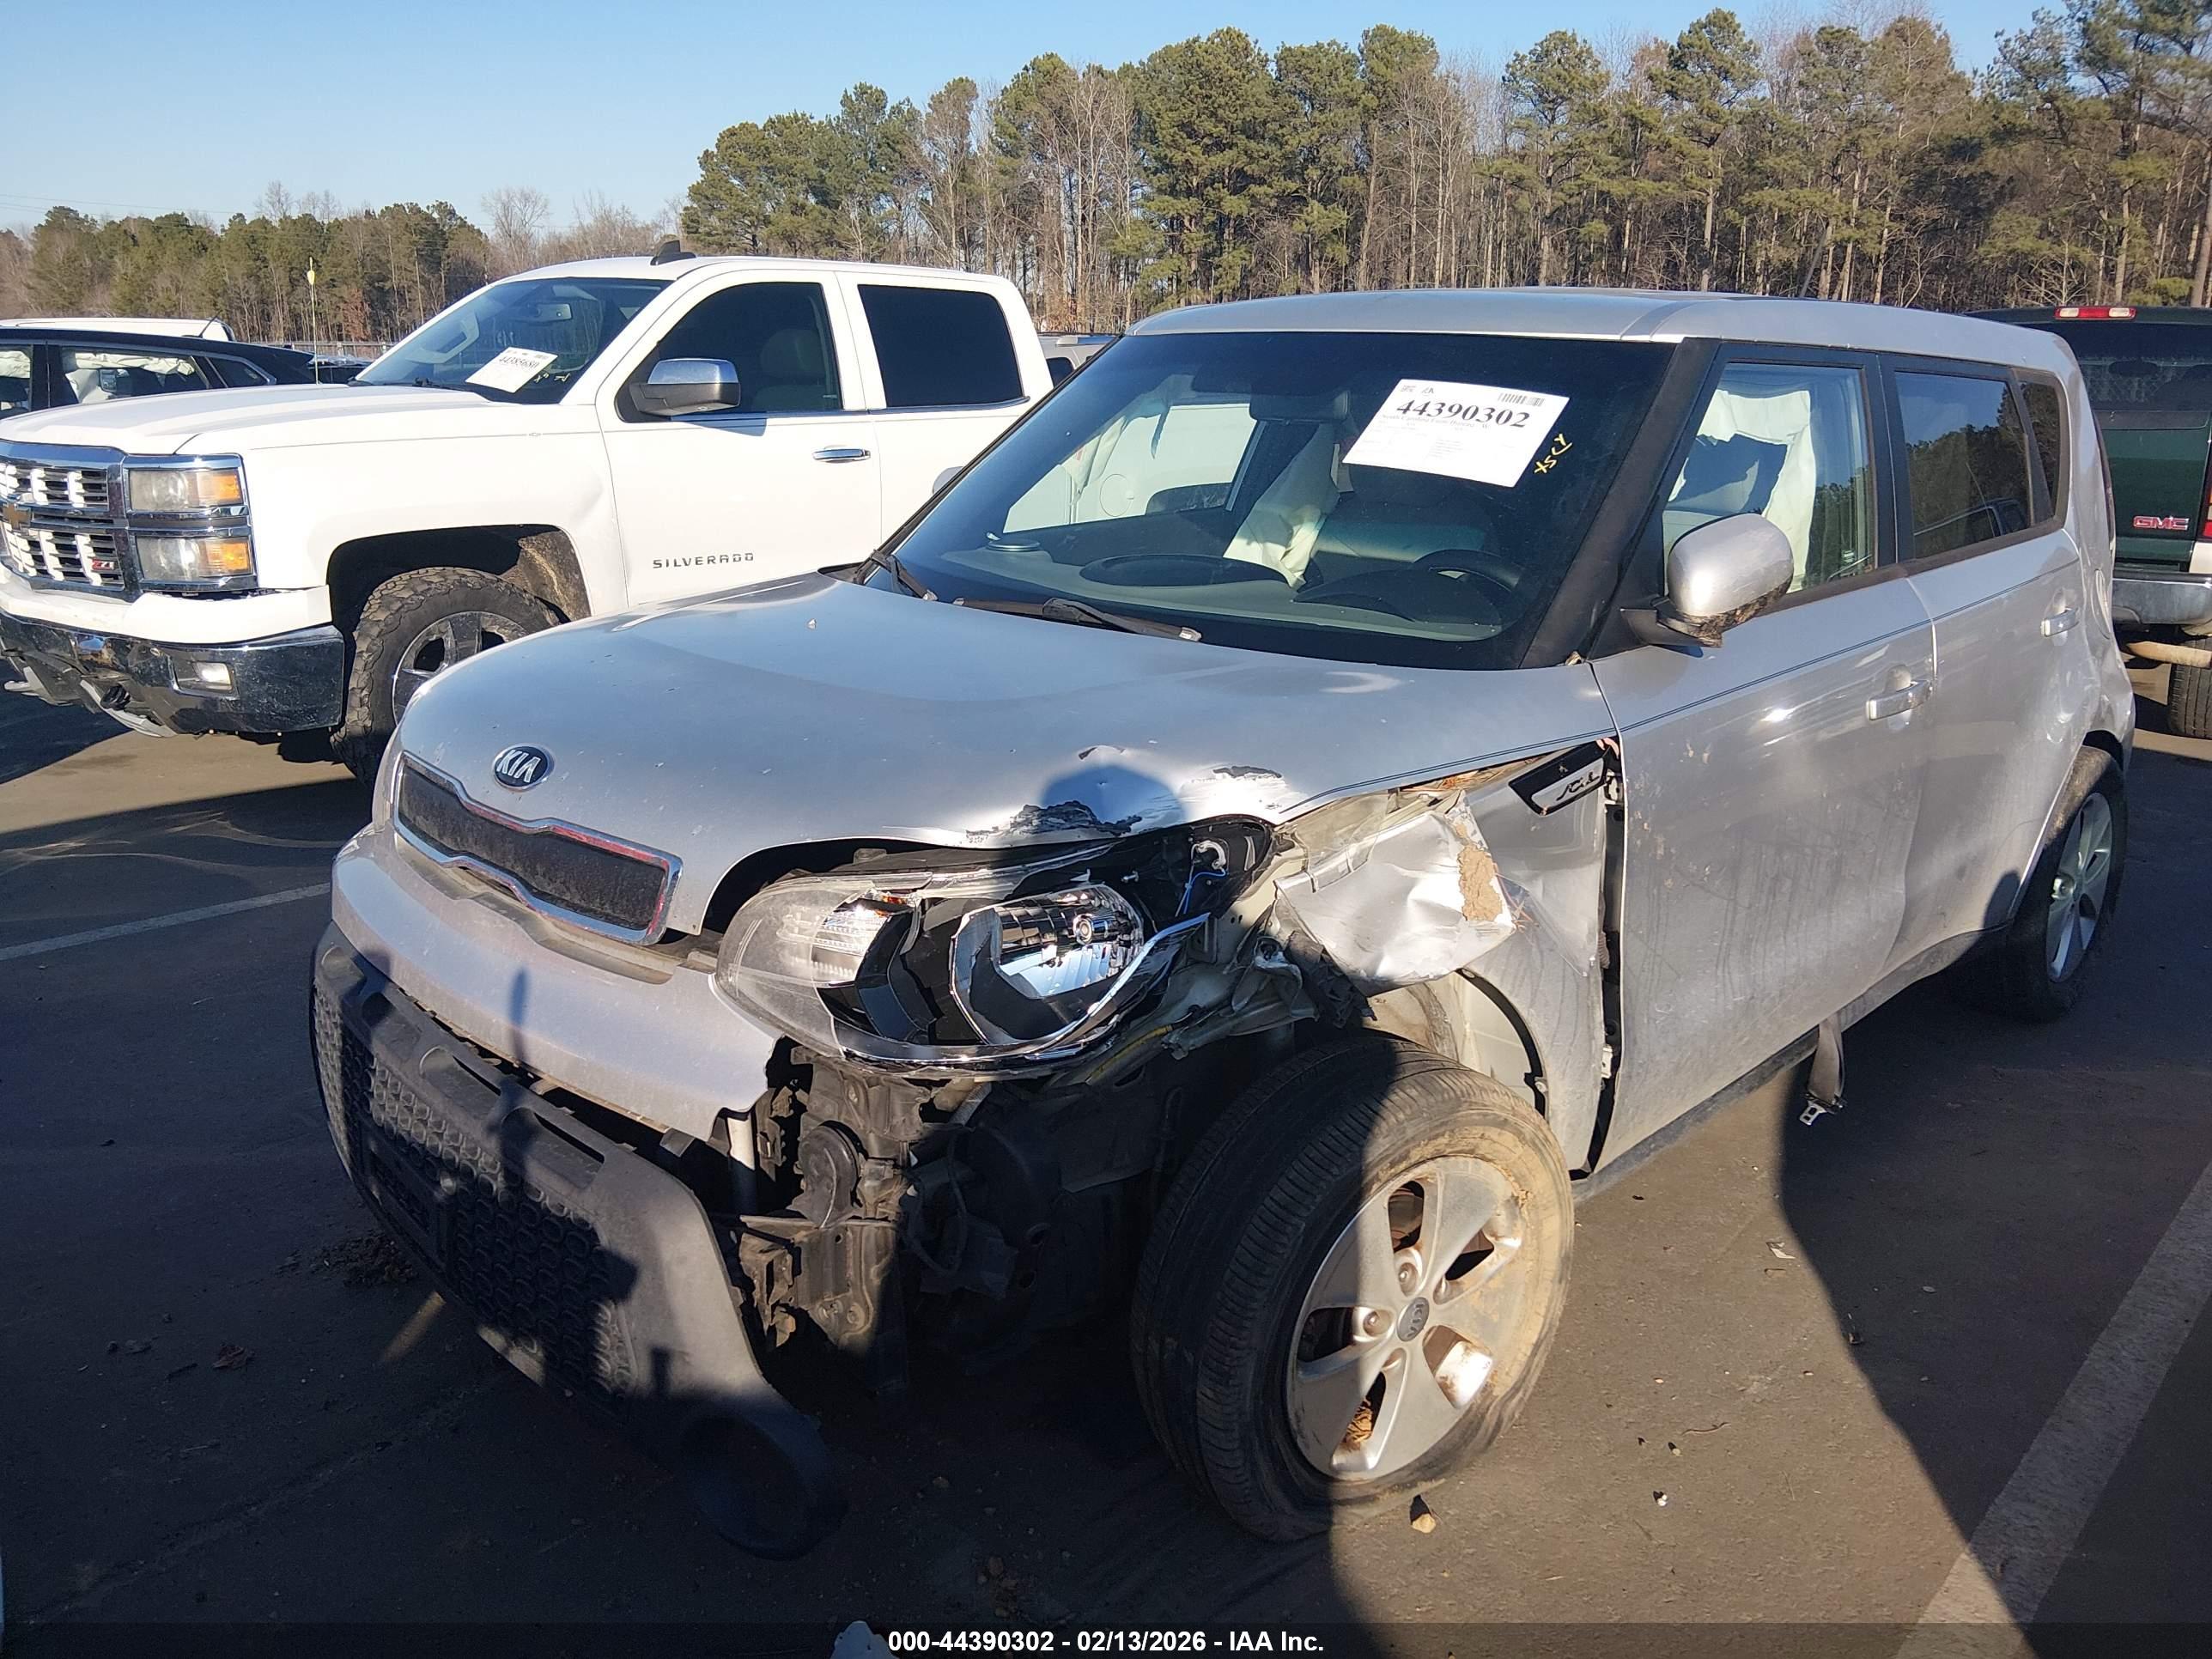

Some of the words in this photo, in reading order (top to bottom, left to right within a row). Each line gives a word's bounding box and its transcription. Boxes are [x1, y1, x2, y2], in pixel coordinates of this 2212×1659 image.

[1396, 399, 1530, 428] 44390302
[2132, 515, 2190, 532] GMC
[91, 559, 115, 570] Z71
[653, 552, 754, 568] SILVERADO
[495, 749, 541, 783] KIA
